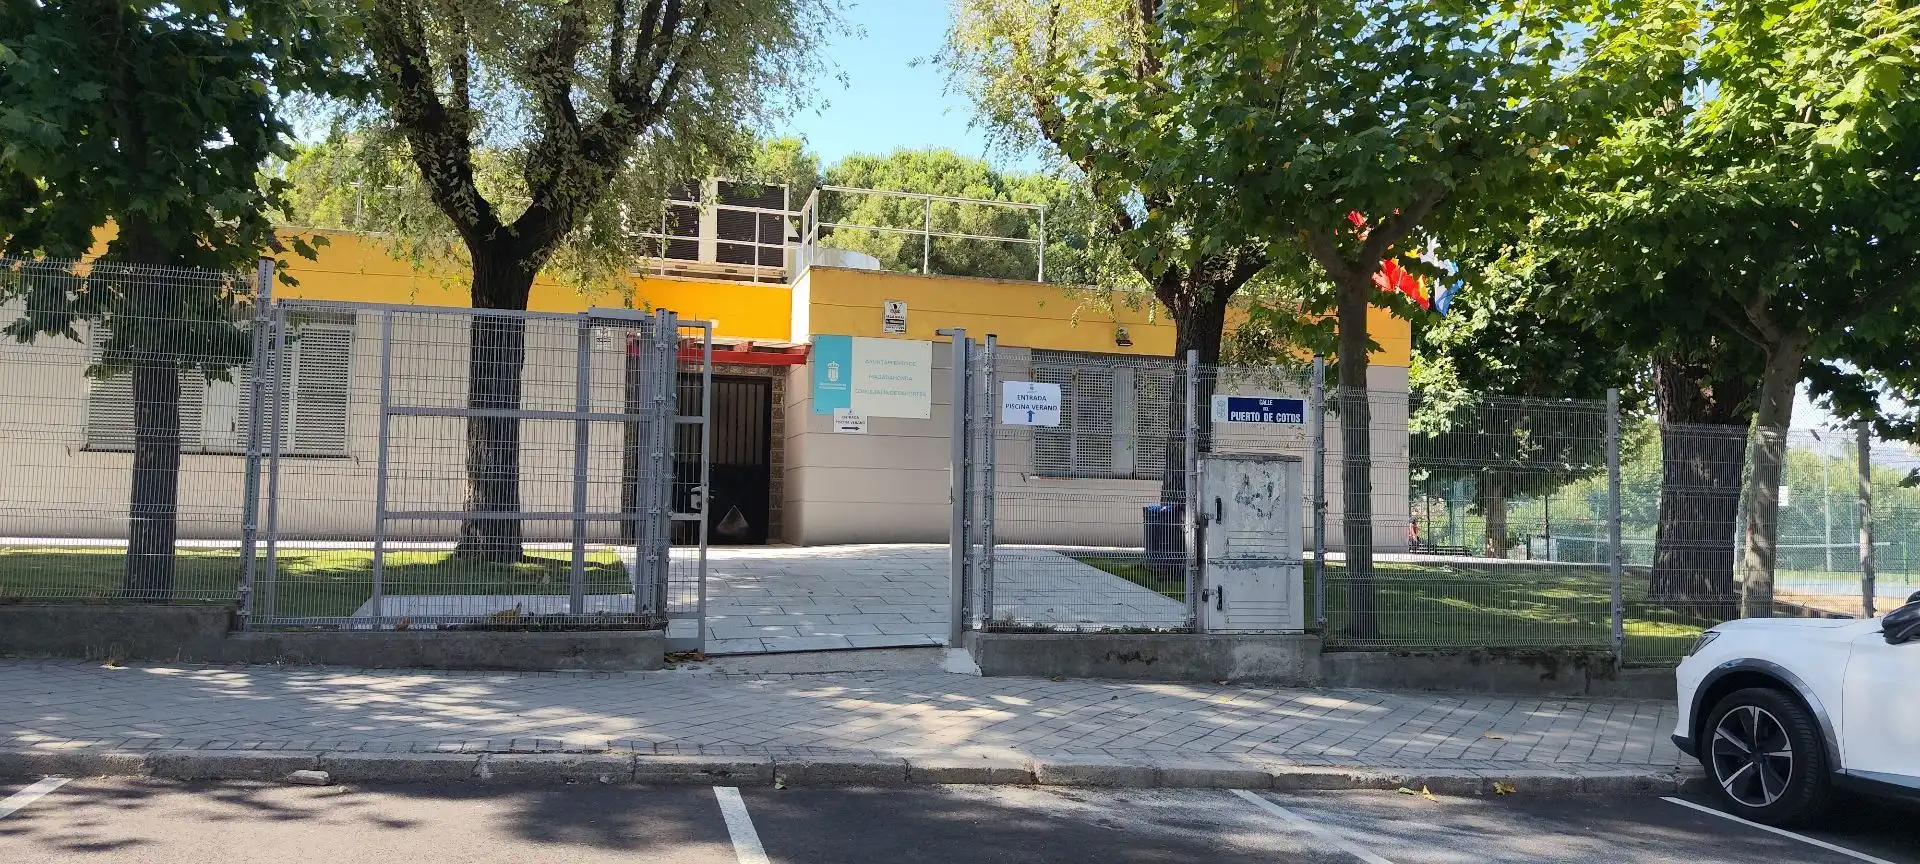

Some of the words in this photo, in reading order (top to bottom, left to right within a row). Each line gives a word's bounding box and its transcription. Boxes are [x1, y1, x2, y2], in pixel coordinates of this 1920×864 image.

[1230, 411, 1260, 421] PUERTO
[1264, 413, 1274, 422] DE
[1276, 413, 1300, 422] COTOS
